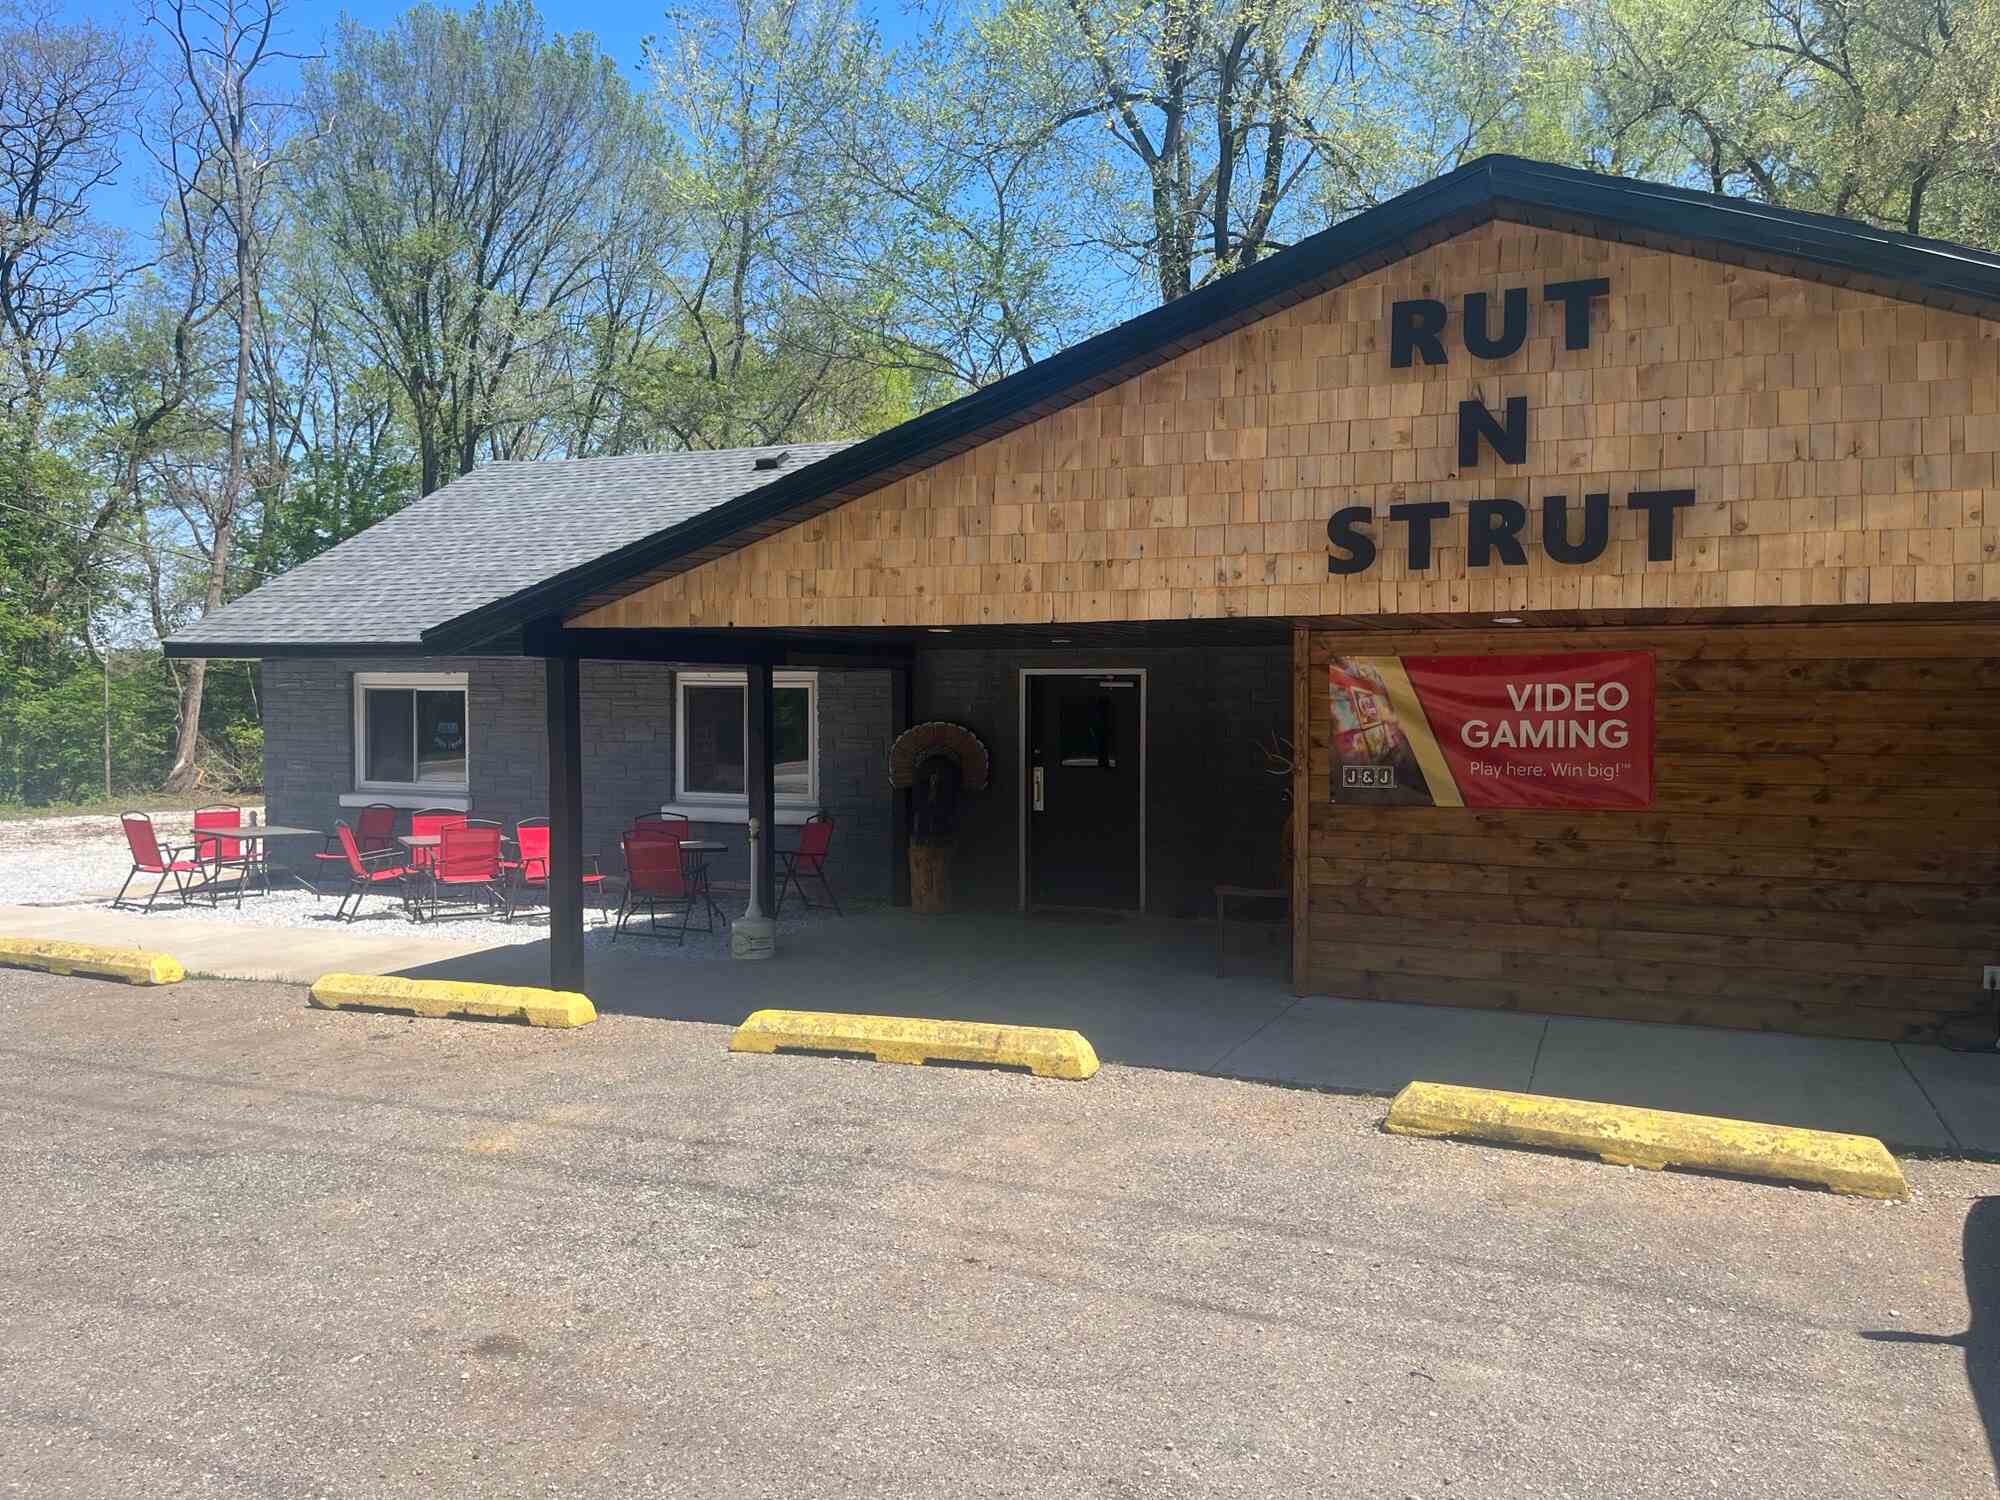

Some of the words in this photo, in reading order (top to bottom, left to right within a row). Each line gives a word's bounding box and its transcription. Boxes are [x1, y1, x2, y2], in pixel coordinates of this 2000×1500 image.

[1390, 277, 1610, 368] RUT
[1458, 396, 1528, 467] N
[1327, 489, 1696, 575] STRUT
[1506, 682, 1630, 712] VIDEO
[1461, 719, 1629, 749] GAMING
[1470, 761, 1503, 779] Play
[1506, 761, 1547, 777] here.
[1551, 762, 1583, 777] Win
